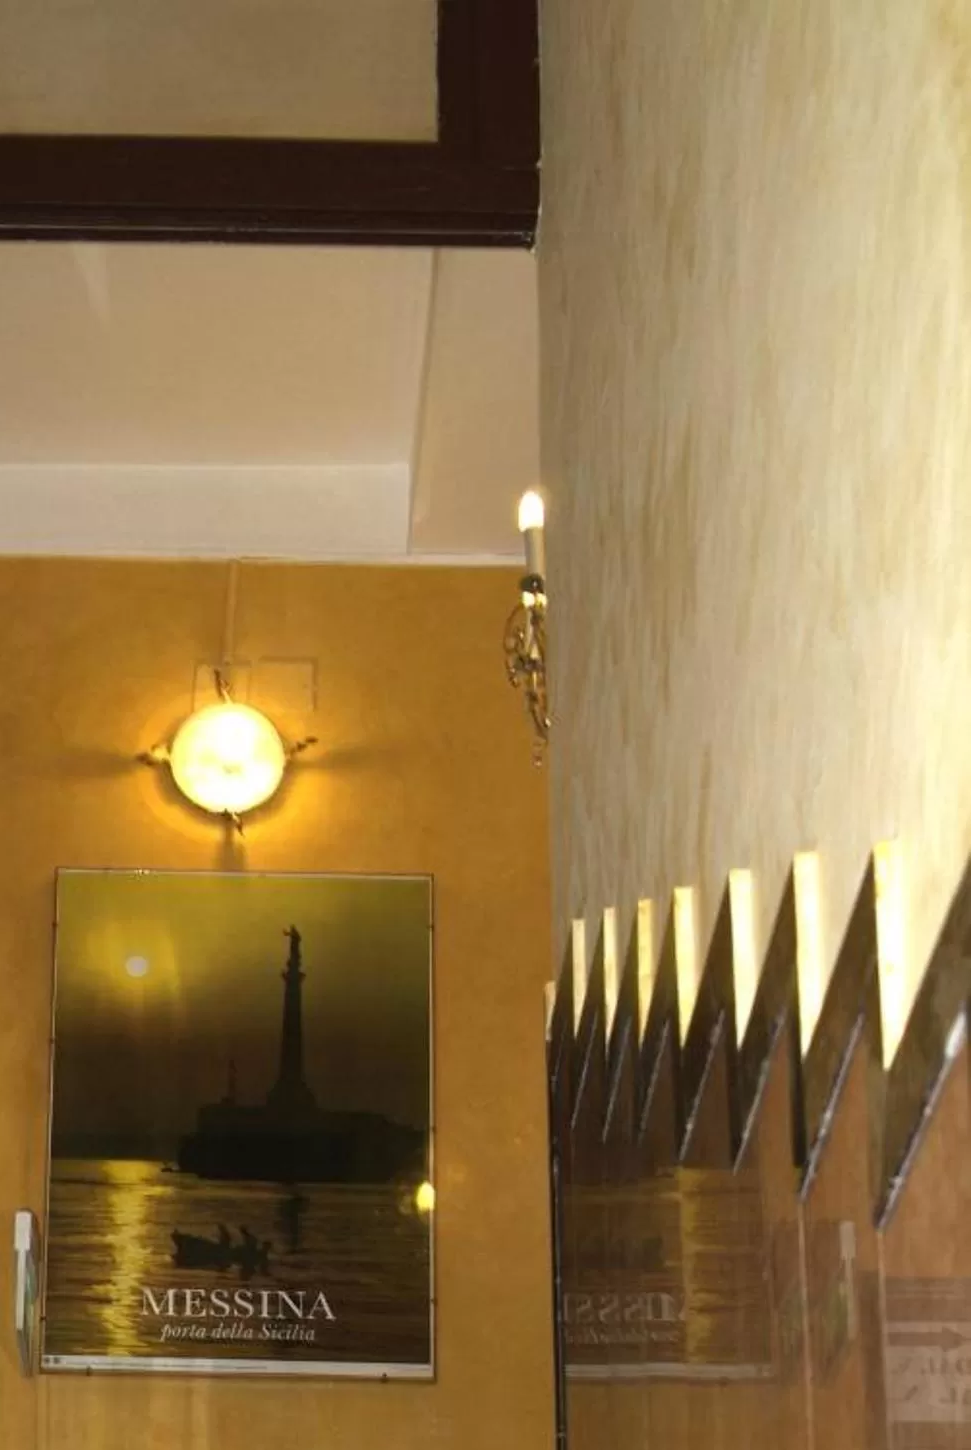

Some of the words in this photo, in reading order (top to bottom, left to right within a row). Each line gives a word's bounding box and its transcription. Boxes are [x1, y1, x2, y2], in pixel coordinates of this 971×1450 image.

[139, 1286, 337, 1321] MESSINA
[160, 1323, 207, 1342] porta
[210, 1322, 254, 1340] della
[258, 1323, 316, 1342] Sicilia
